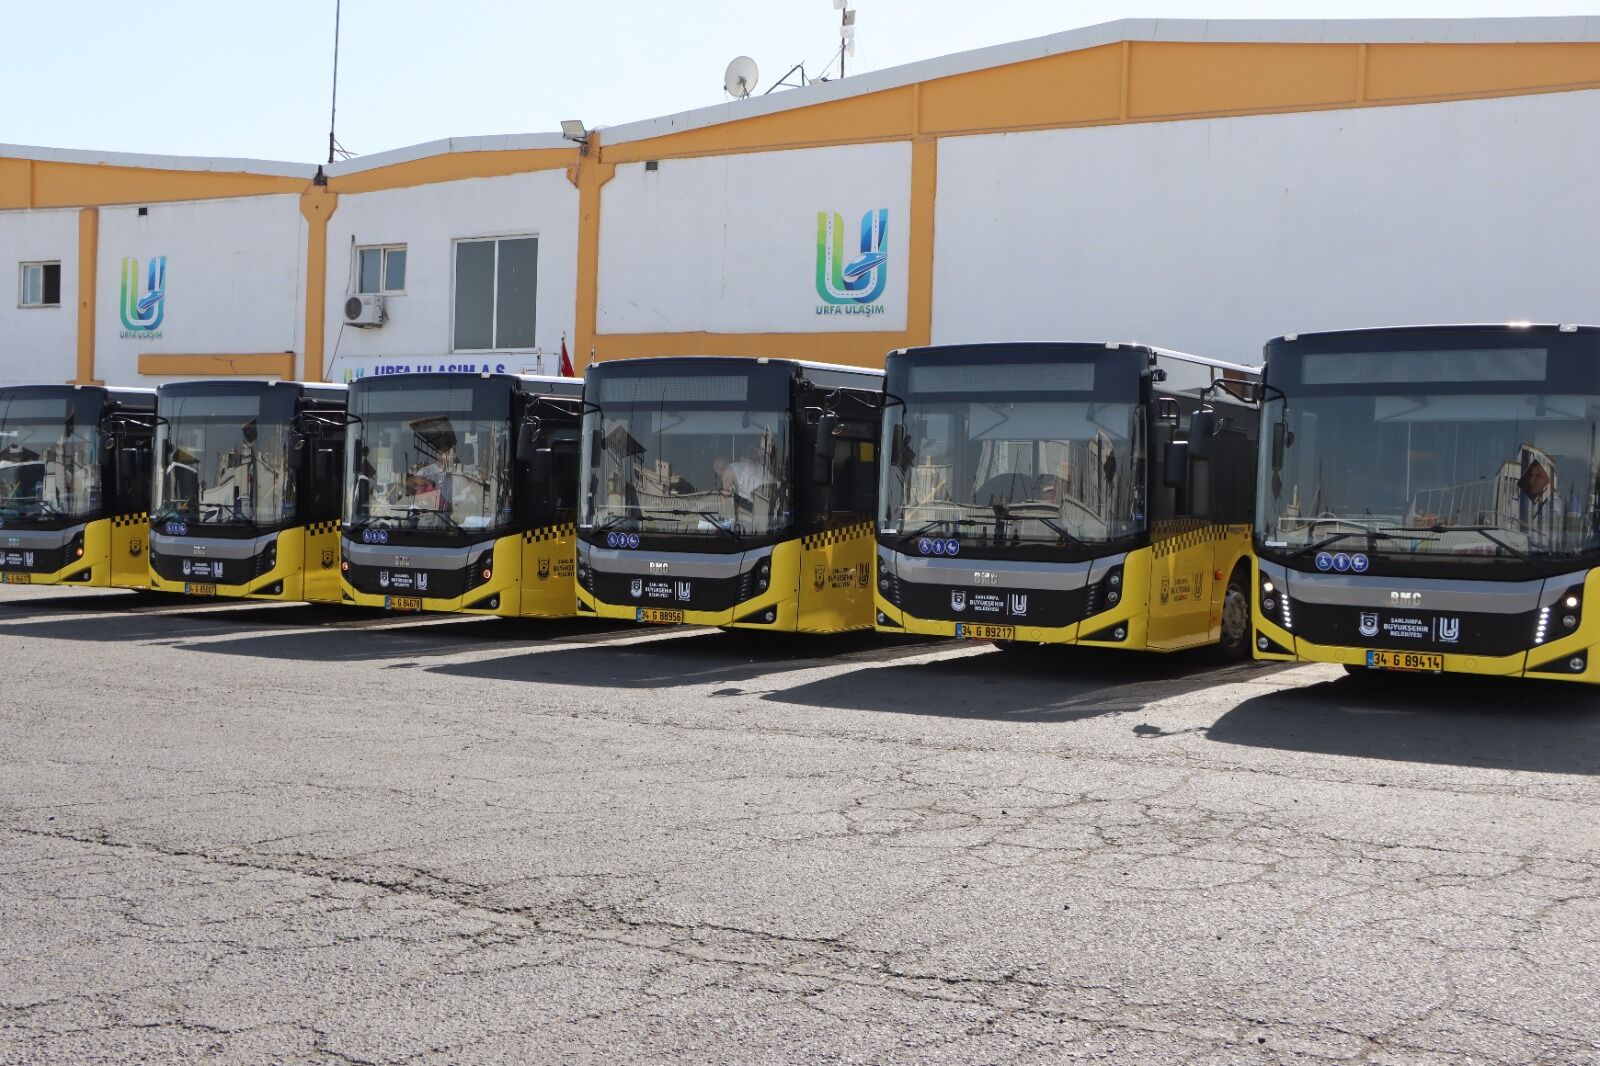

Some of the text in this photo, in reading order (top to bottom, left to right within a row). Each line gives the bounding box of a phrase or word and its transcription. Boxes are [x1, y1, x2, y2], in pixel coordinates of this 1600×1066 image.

[816, 305, 885, 317] URFA ULAŞIM
[1390, 591, 1422, 606] BMC
[961, 625, 1012, 639] 34 G 89217
[1374, 653, 1440, 669] 34 G 89414
